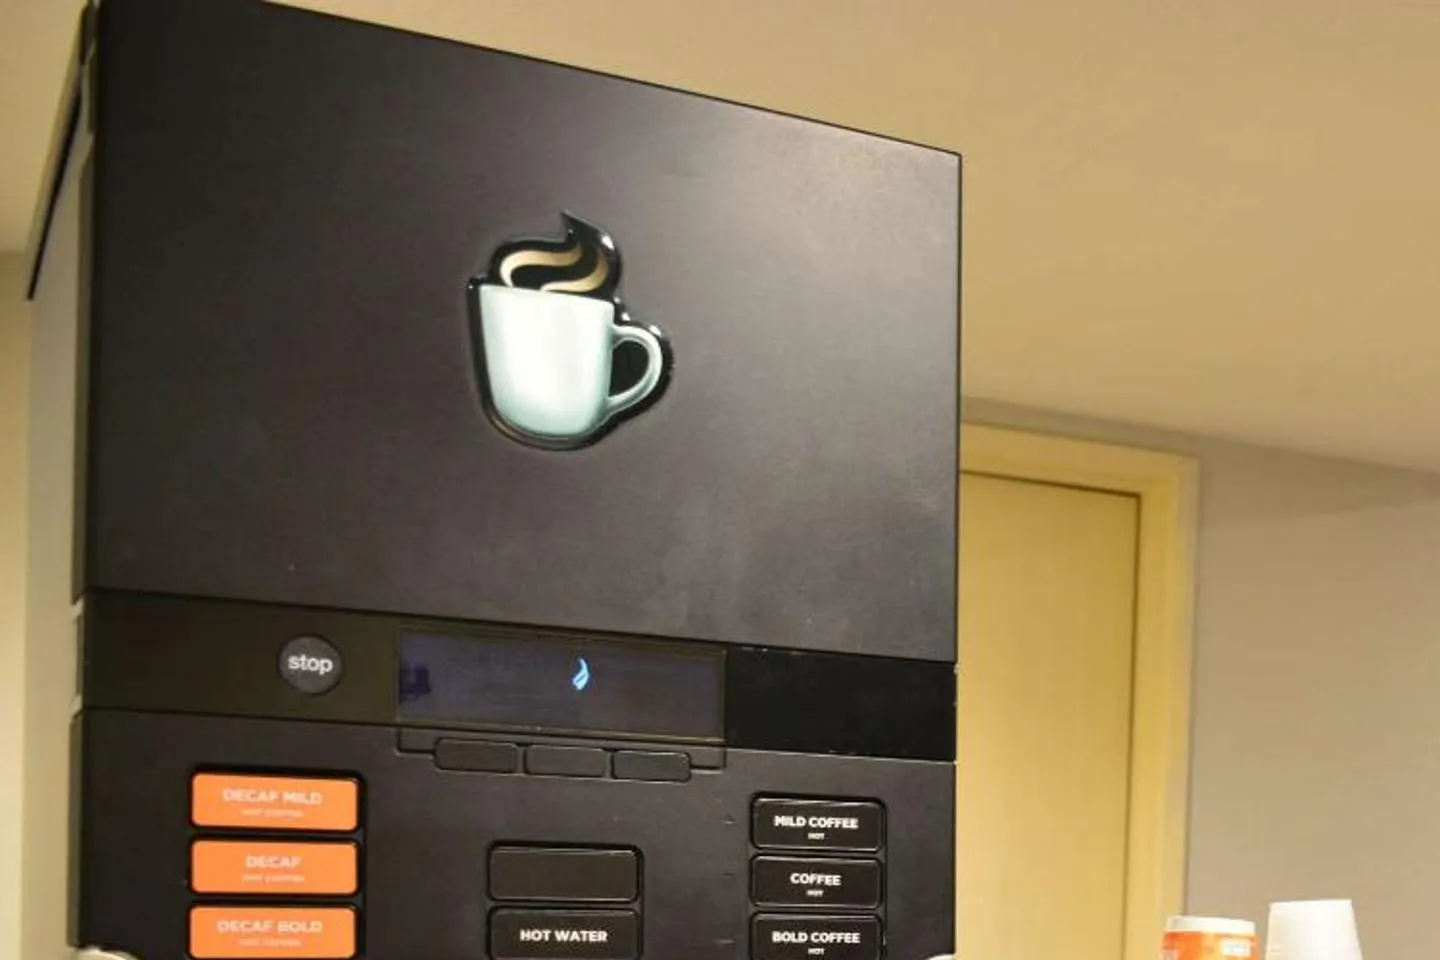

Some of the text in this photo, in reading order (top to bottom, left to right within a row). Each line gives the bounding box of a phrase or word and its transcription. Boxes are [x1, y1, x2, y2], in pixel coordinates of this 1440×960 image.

[288, 653, 334, 676] stop
[222, 787, 324, 806] DECAF MILD
[773, 815, 860, 830] MILD COFFEE
[244, 855, 302, 869] DECAF
[789, 872, 842, 887] COFFEE
[216, 920, 323, 934] DECAF BOLD
[519, 928, 609, 944] HOT WATER
[771, 930, 862, 945] BOLD COFFEE
